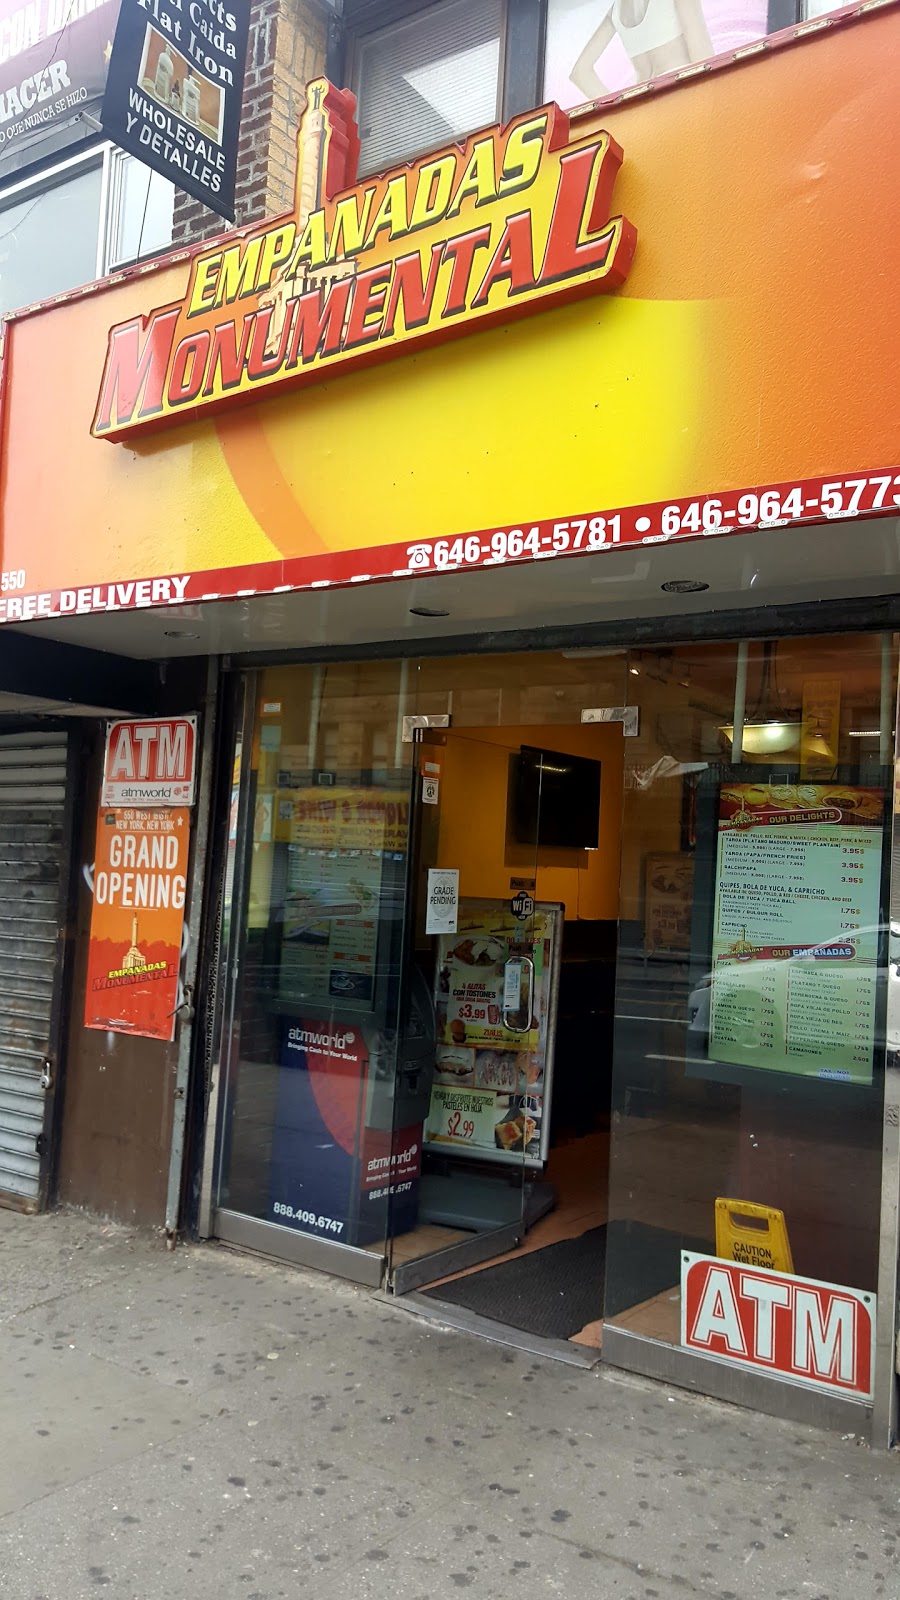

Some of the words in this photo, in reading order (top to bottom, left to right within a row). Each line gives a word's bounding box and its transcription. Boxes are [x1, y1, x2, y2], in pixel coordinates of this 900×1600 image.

[189, 2, 237, 60] Caida
[187, 30, 234, 87] Iron
[24, 104, 56, 130] NUNCA
[54, 98, 67, 113] SE
[66, 86, 88, 108] HIZO
[129, 88, 226, 173] WHOLESALE
[125, 113, 138, 134] Y
[139, 126, 222, 193] DETALLES
[188, 114, 549, 317] EMPANADAS
[433, 515, 622, 566] 646-964-5781
[1, 569, 26, 592] 550
[59, 575, 191, 612] DELIVERY
[108, 724, 188, 779] ATM
[121, 787, 172, 798] atmworld
[116, 820, 128, 830] NEW
[146, 820, 159, 830] NEW
[769, 816, 788, 824] OUR
[789, 811, 836, 823] DELIGHTS
[110, 835, 179, 870] GRAND
[95, 872, 186, 909] OPENING
[433, 886, 454, 895] GRADE
[719, 881, 742, 889] QUIPES,
[768, 885, 787, 893] YUCA,
[794, 887, 826, 895] CAPRICHO
[430, 896, 456, 905] PENDING
[772, 949, 791, 957] OUR
[792, 948, 852, 957] EMPANADAS
[108, 961, 167, 978] EMPANADAS
[453, 988, 466, 997] CON
[466, 990, 497, 999] TOSTONES
[458, 1003, 486, 1019] $3.99
[288, 1027, 347, 1049] atmworld
[287, 1041, 309, 1053] Bringing
[308, 1046, 322, 1054] Cash
[342, 1052, 358, 1062] World
[788, 1046, 822, 1055] CAMARONES
[442, 1100, 463, 1111] PASTELES
[463, 1101, 470, 1112] EN
[447, 1111, 475, 1138] $2.99
[367, 1149, 412, 1171] atmwrld
[273, 1201, 344, 1234] 888.409.6747
[732, 1251, 750, 1264] Wet
[751, 1256, 775, 1270] Floor
[733, 1242, 772, 1259] CAUTION
[690, 1266, 858, 1386] ATM
